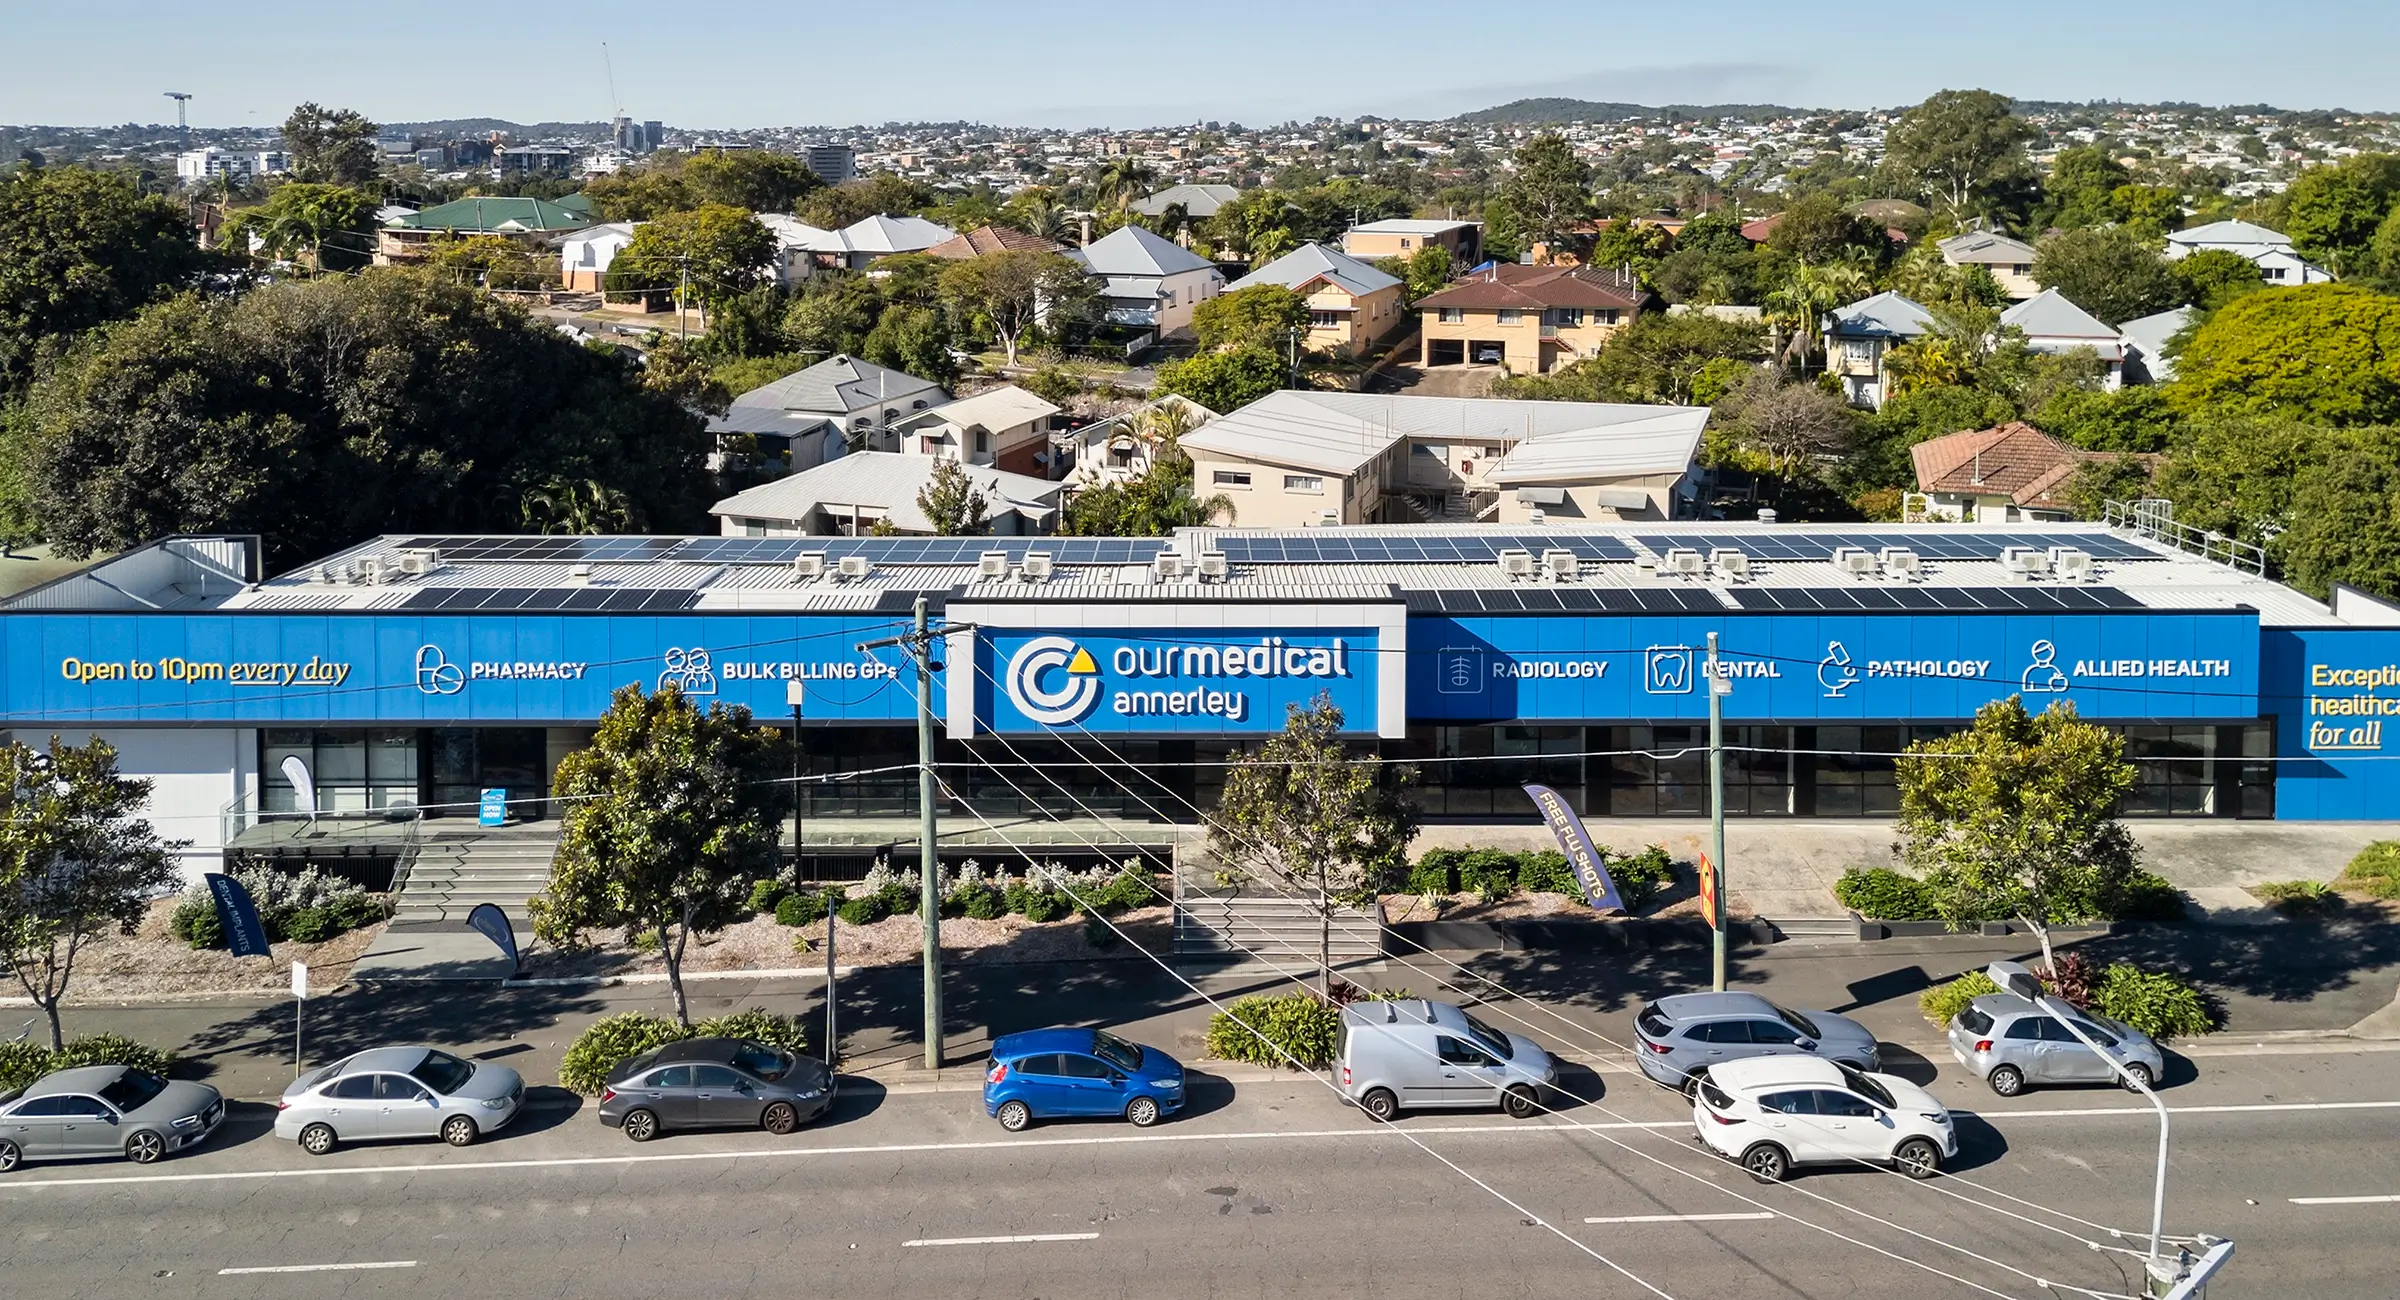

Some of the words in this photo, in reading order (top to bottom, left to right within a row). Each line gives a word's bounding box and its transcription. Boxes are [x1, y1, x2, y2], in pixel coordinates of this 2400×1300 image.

[62, 657, 125, 684] Open
[131, 659, 153, 680] to
[159, 657, 223, 684] 10pm
[229, 663, 297, 686] every
[303, 655, 349, 686] day
[471, 661, 586, 679] PHARMACY
[723, 662, 776, 679] BULK
[780, 662, 857, 679] BILLING
[860, 662, 898, 679] GPs
[1113, 637, 1347, 675] ourmedical
[1493, 661, 1608, 678] RADIOLOGY
[1868, 660, 1990, 678] PATHOLOGY
[2073, 660, 2145, 676] ALLIED
[2149, 659, 2230, 676] HEALTH
[1113, 686, 1242, 719] annerley
[2309, 720, 2345, 749] for
[2349, 720, 2381, 746] all
[1540, 792, 1568, 826] FREE
[1560, 825, 1583, 852] FLU
[1575, 851, 1606, 898] SHOTS
[217, 879, 235, 910] DENTAL
[229, 910, 250, 952] IMPLANTS
